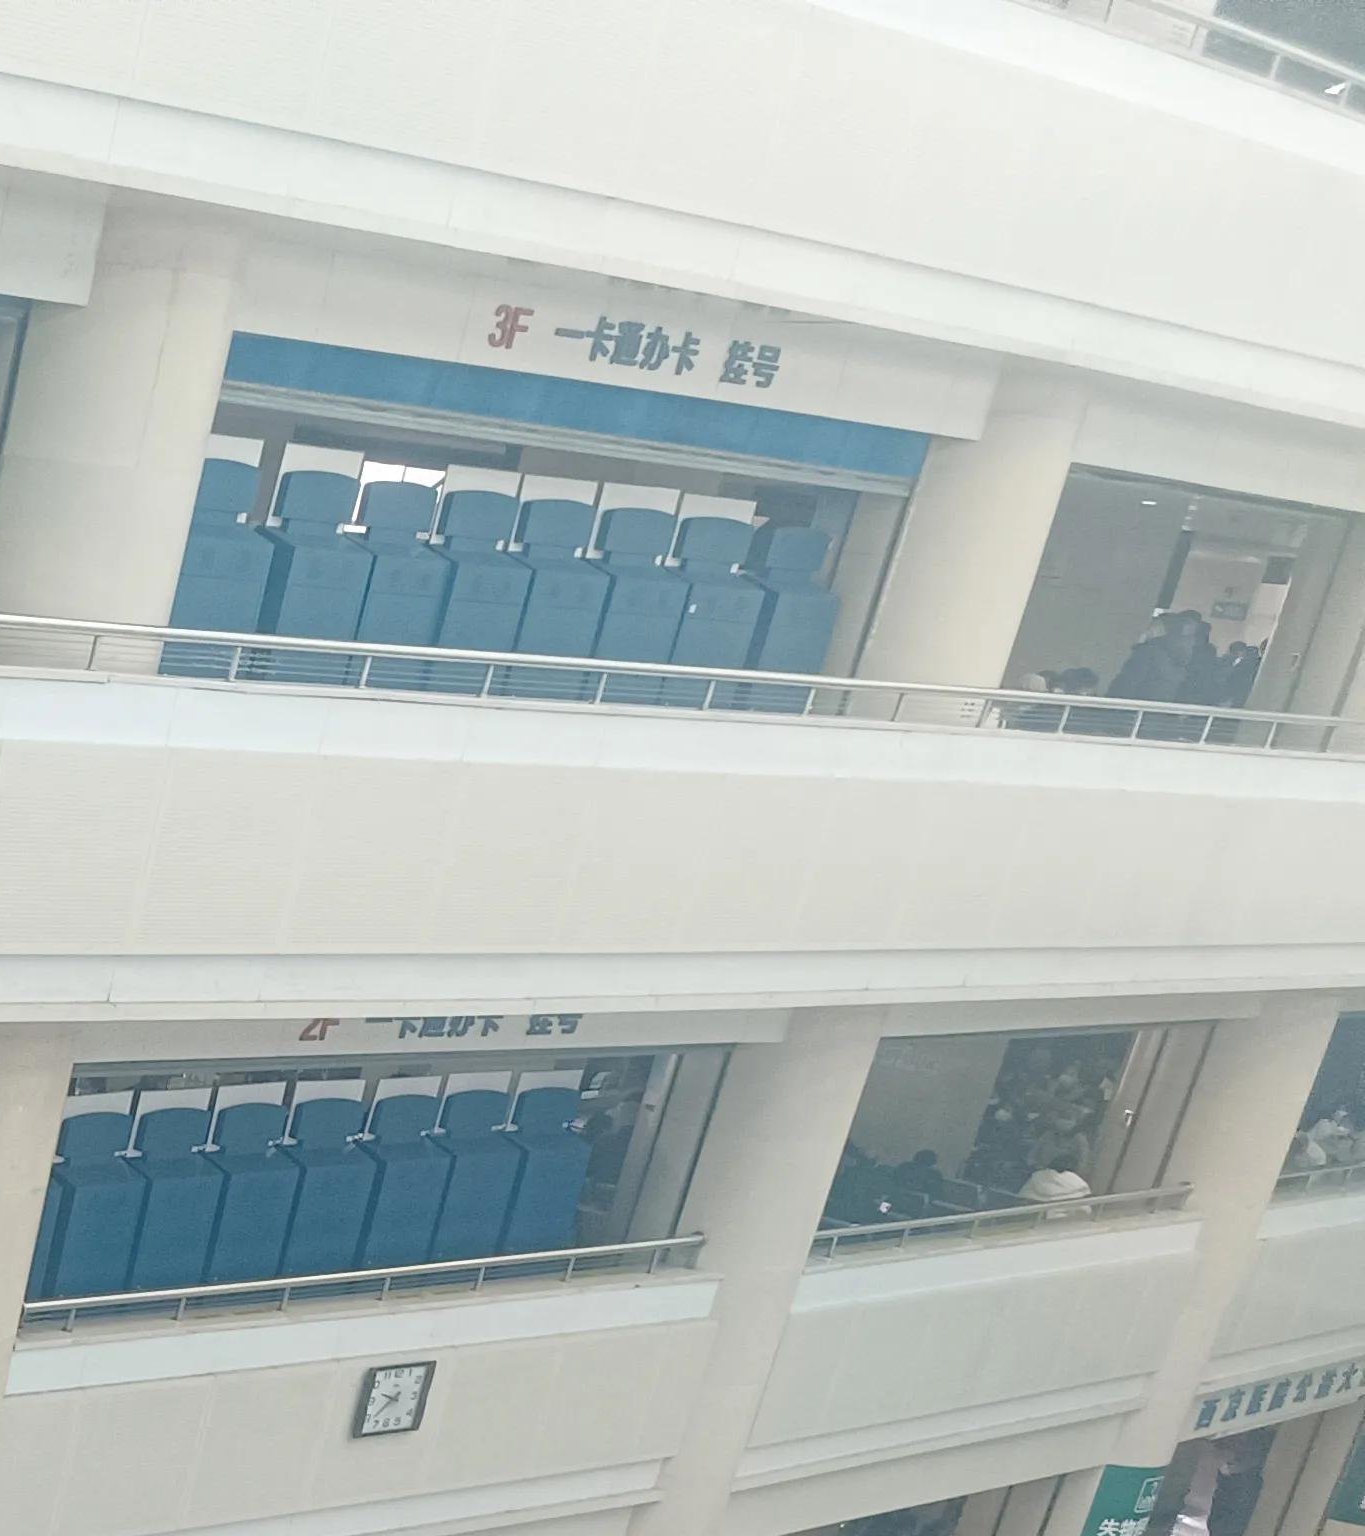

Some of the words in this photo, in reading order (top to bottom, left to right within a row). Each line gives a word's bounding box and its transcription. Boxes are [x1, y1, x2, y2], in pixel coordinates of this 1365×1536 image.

[488, 303, 535, 350] 3F
[554, 315, 701, 376] 一卡通办卡
[719, 339, 782, 389] 挂号
